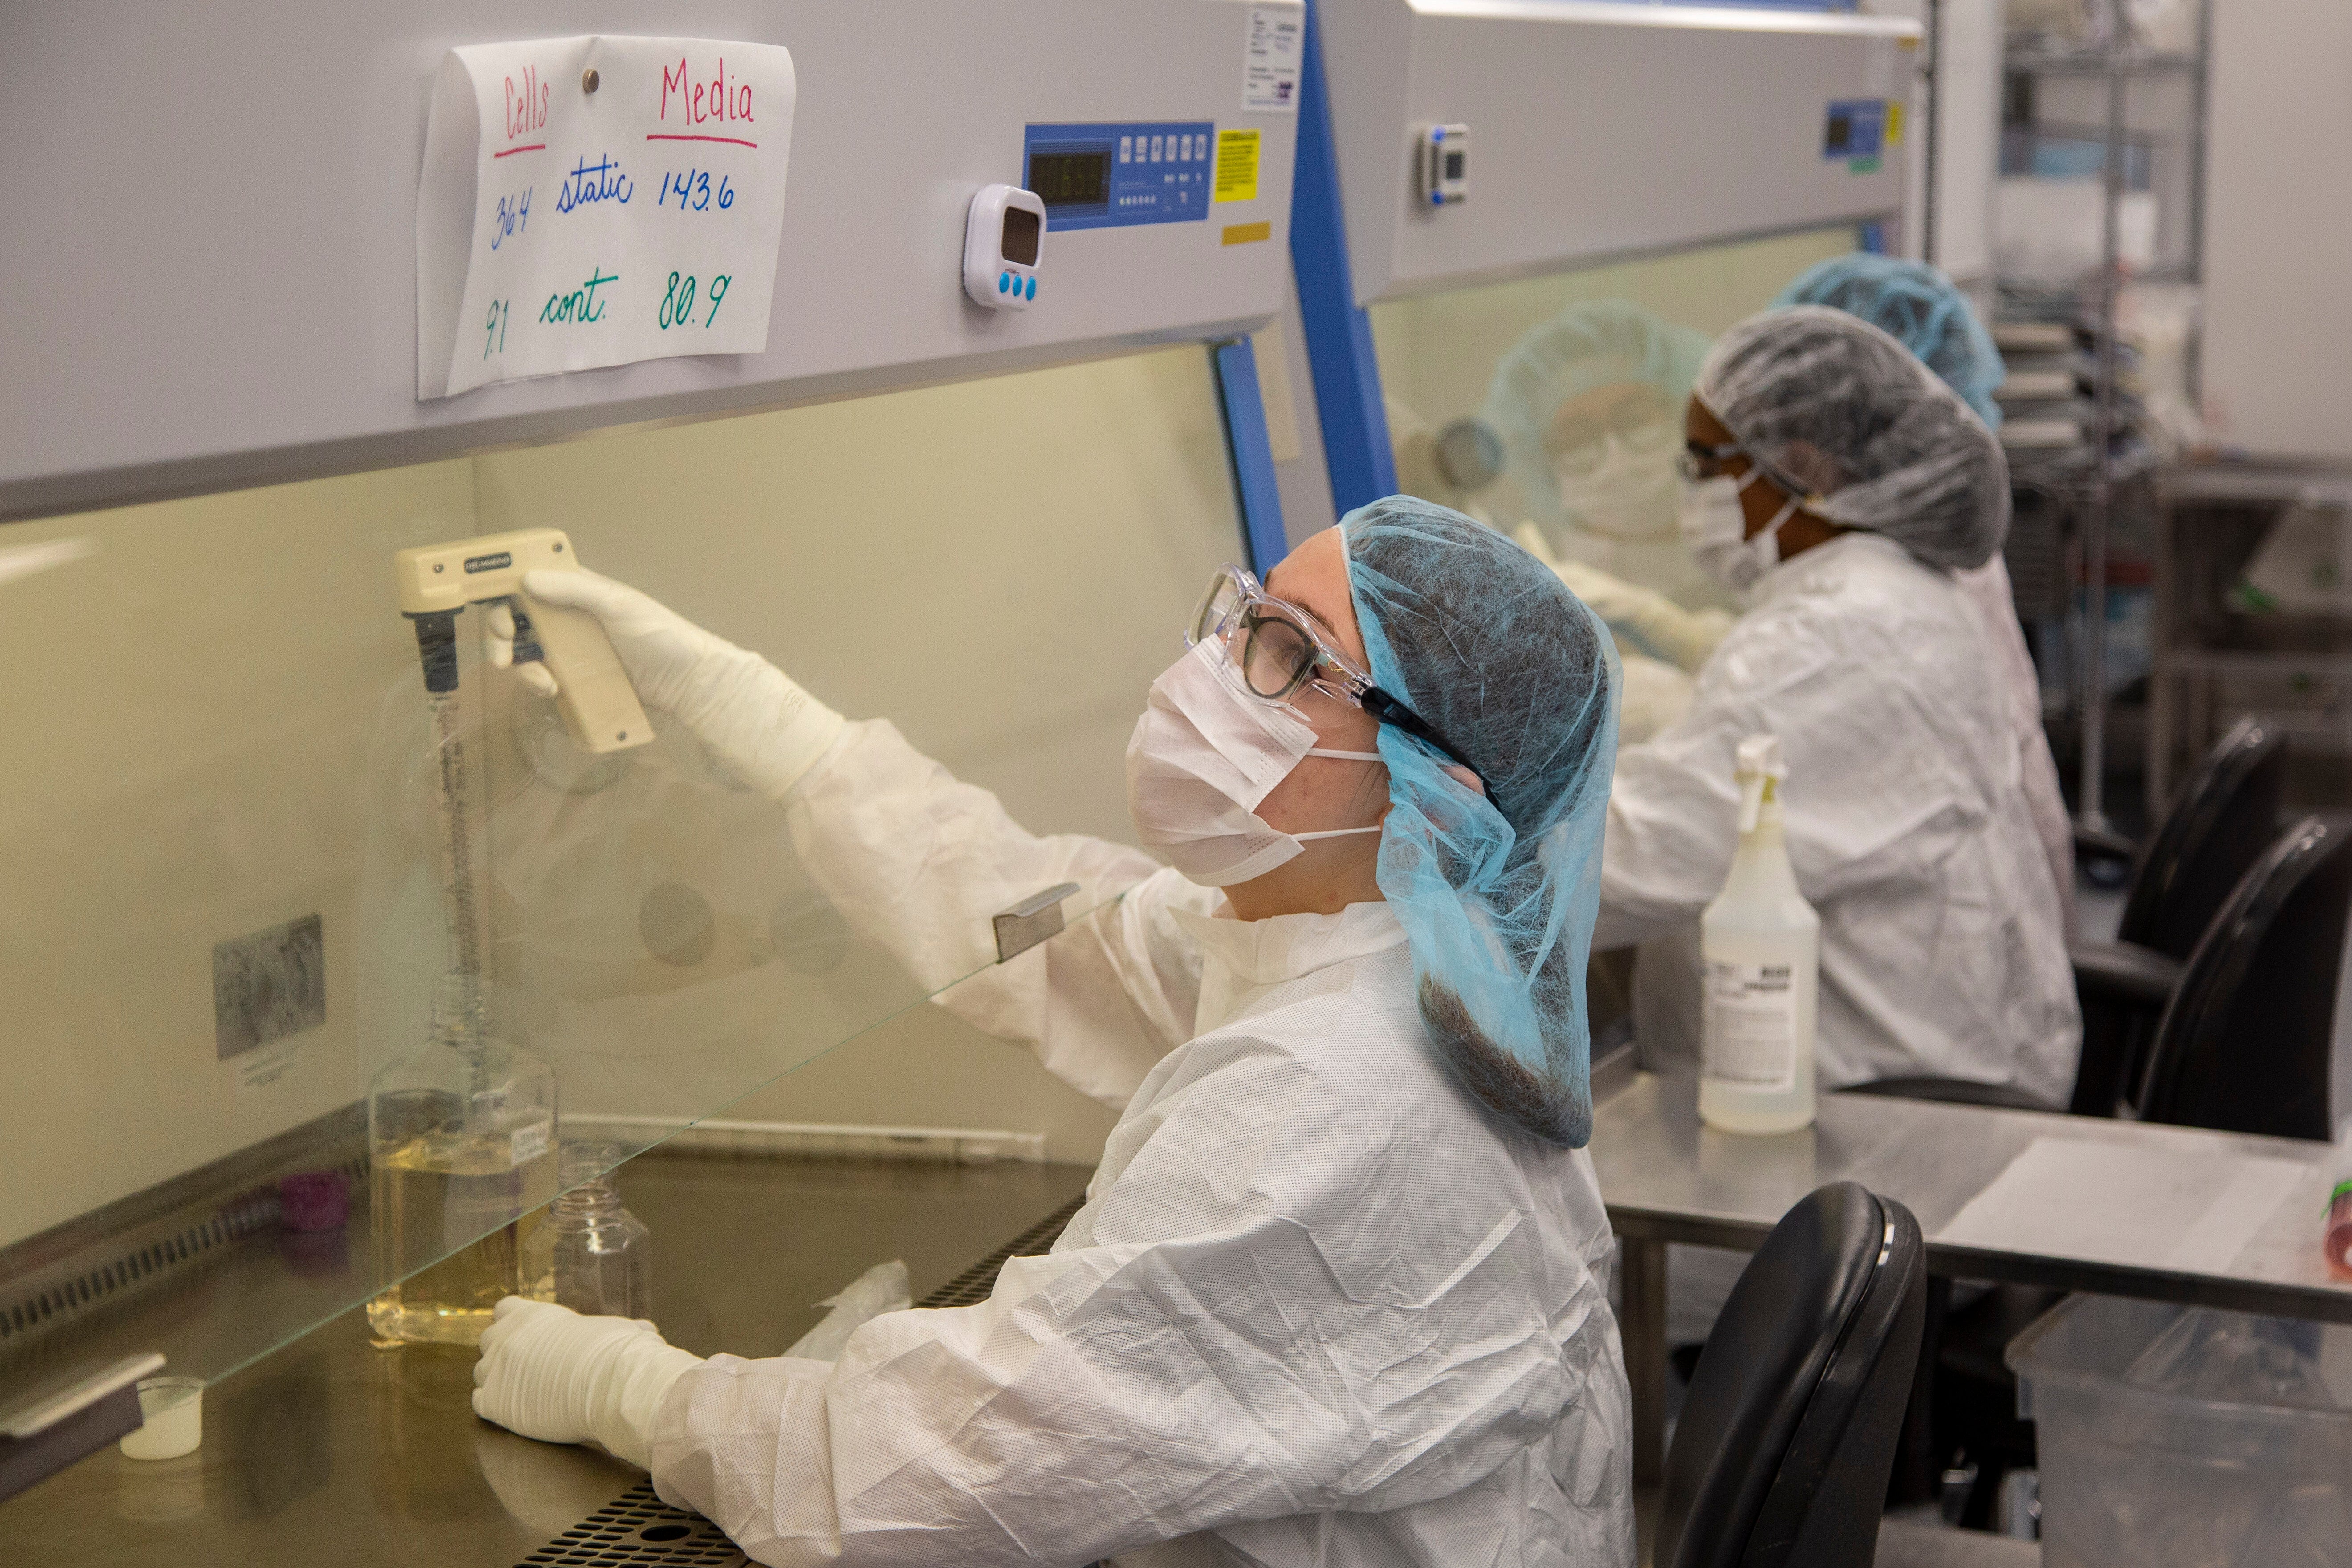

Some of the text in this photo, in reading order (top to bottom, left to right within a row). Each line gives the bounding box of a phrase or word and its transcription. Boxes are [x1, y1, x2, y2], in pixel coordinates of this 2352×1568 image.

[505, 57, 754, 139] Cells Media
[556, 153, 633, 214] static
[658, 168, 735, 212] 143.6
[539, 267, 619, 324] cont.
[659, 271, 732, 330] 80.9
